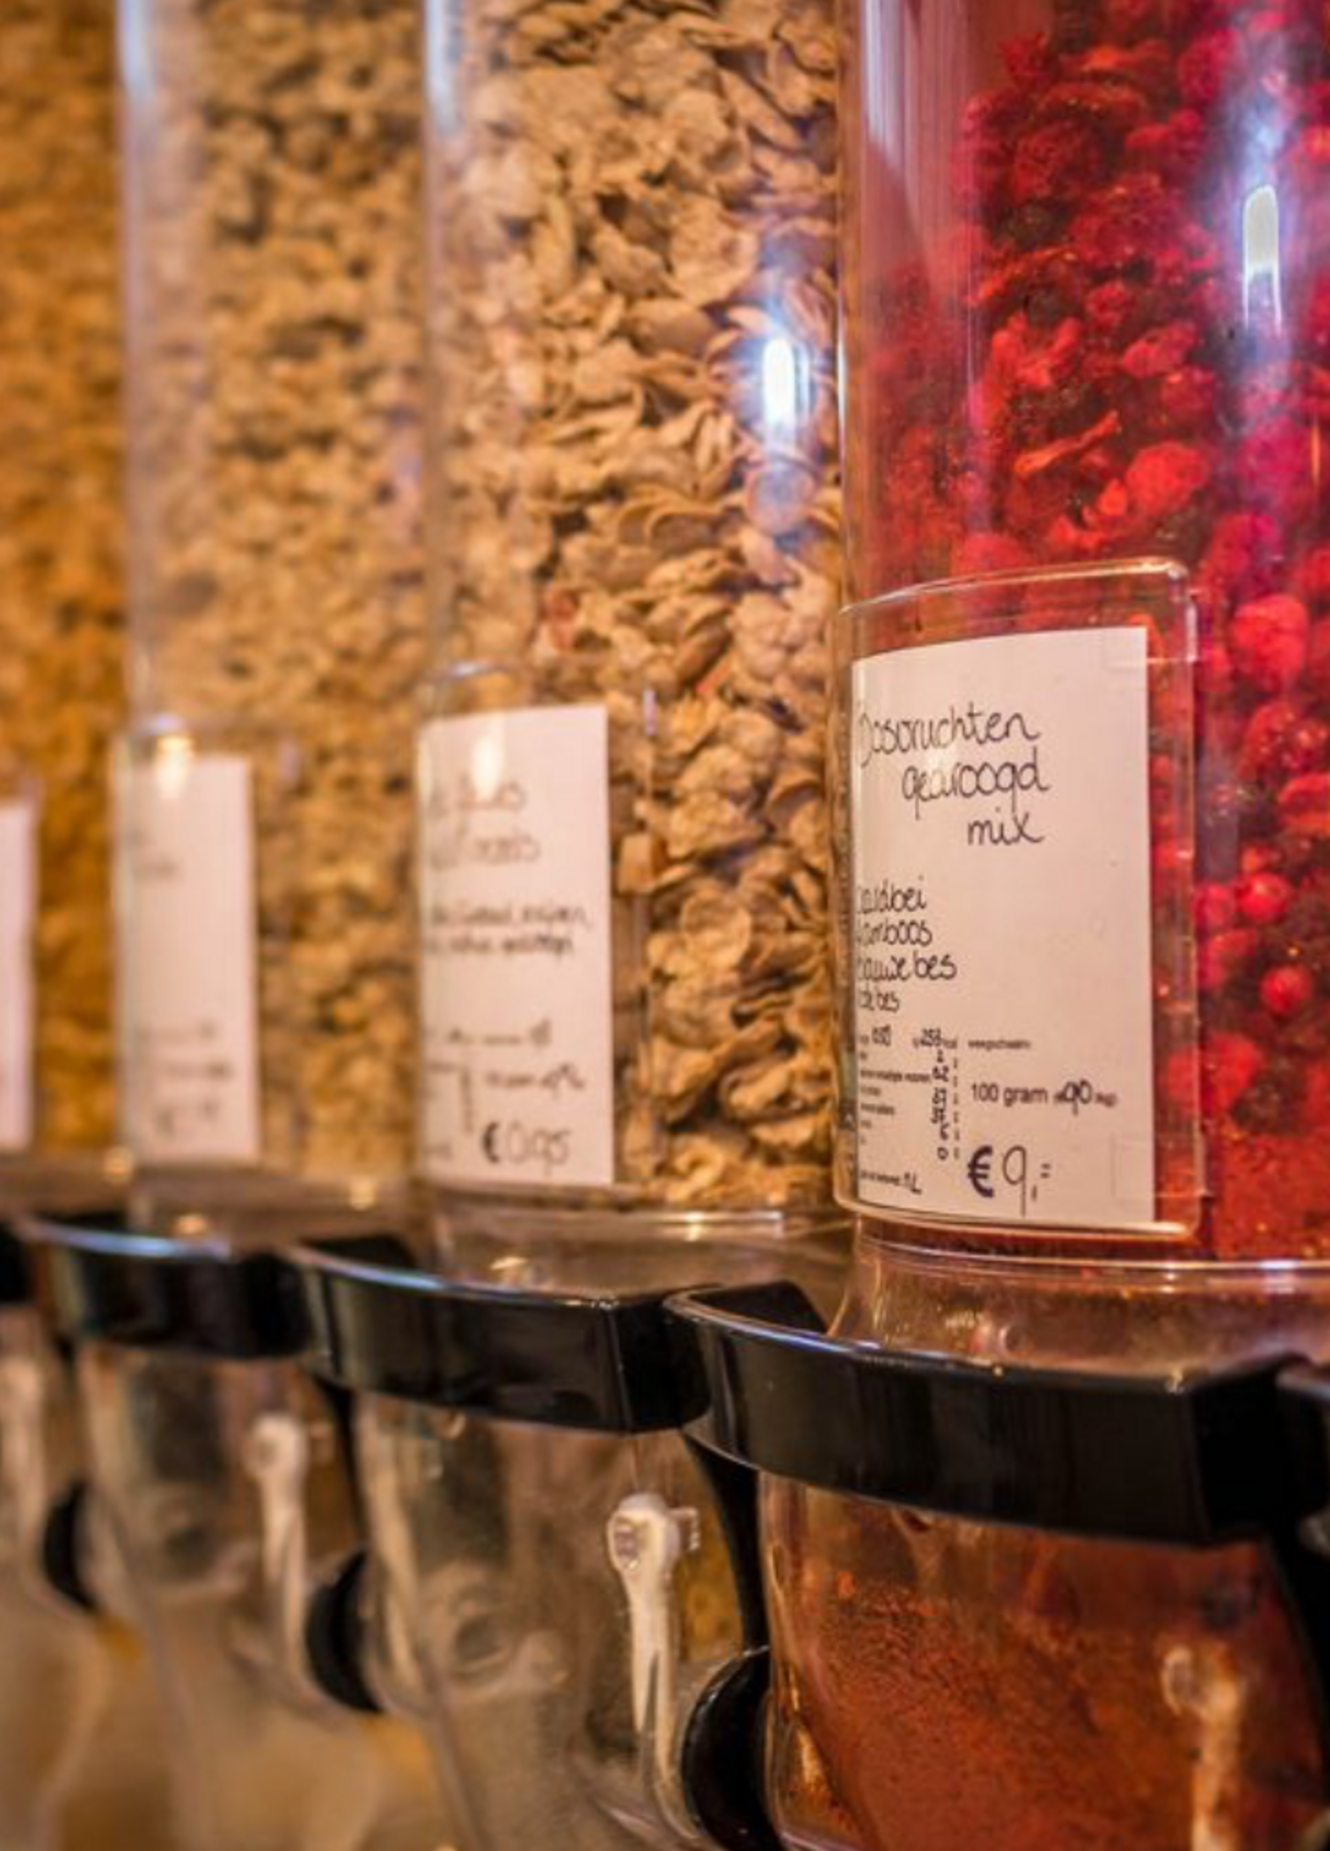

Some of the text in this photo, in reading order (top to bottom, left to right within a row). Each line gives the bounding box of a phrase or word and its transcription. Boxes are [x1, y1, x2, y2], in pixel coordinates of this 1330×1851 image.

[968, 806, 1045, 847] mix
[856, 875, 927, 915] ardbei
[856, 918, 933, 948] amboos
[971, 1082, 1000, 1103] 100
[1003, 1087, 1049, 1107] gram
